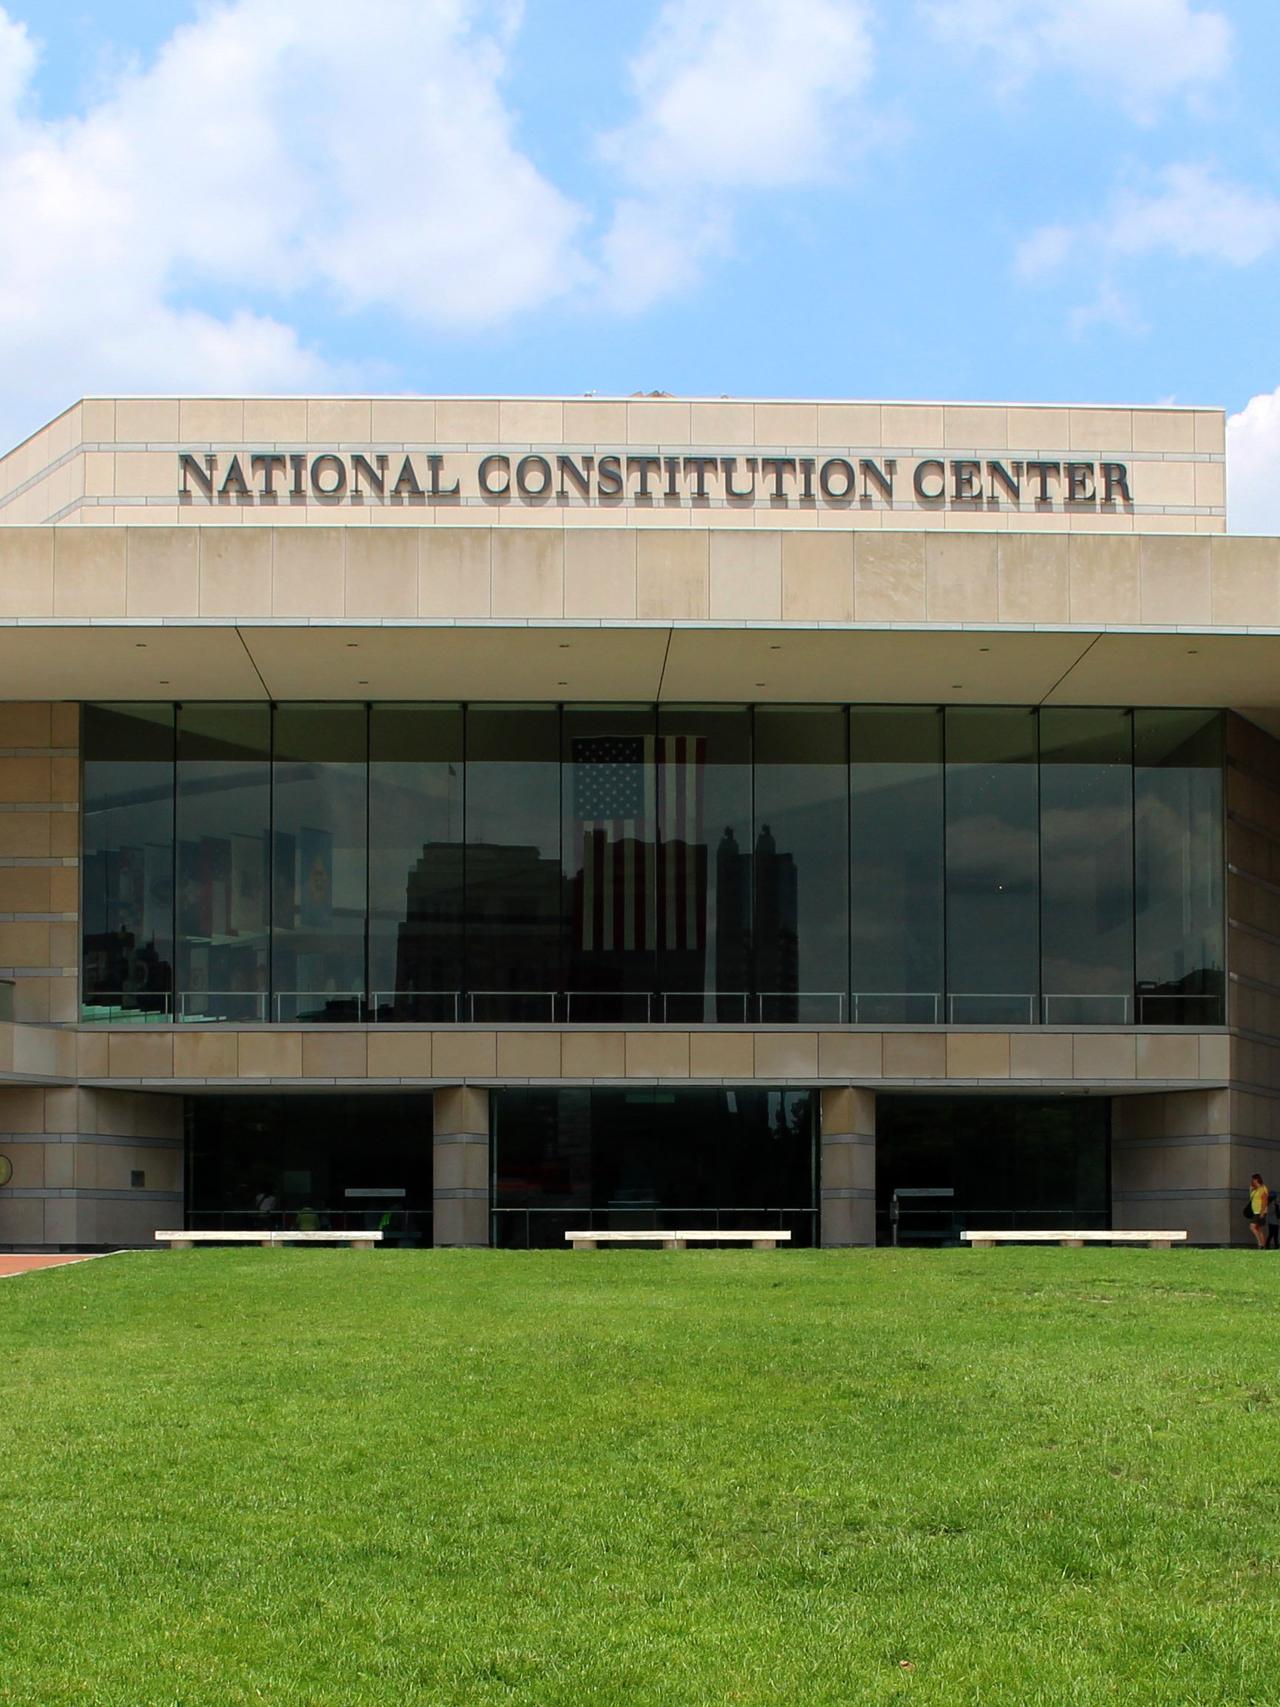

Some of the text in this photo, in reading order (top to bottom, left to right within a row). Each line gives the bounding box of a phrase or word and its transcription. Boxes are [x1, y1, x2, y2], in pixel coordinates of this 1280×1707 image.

[177, 452, 1134, 502] NATIONAL CONSTITUTION CENTER
